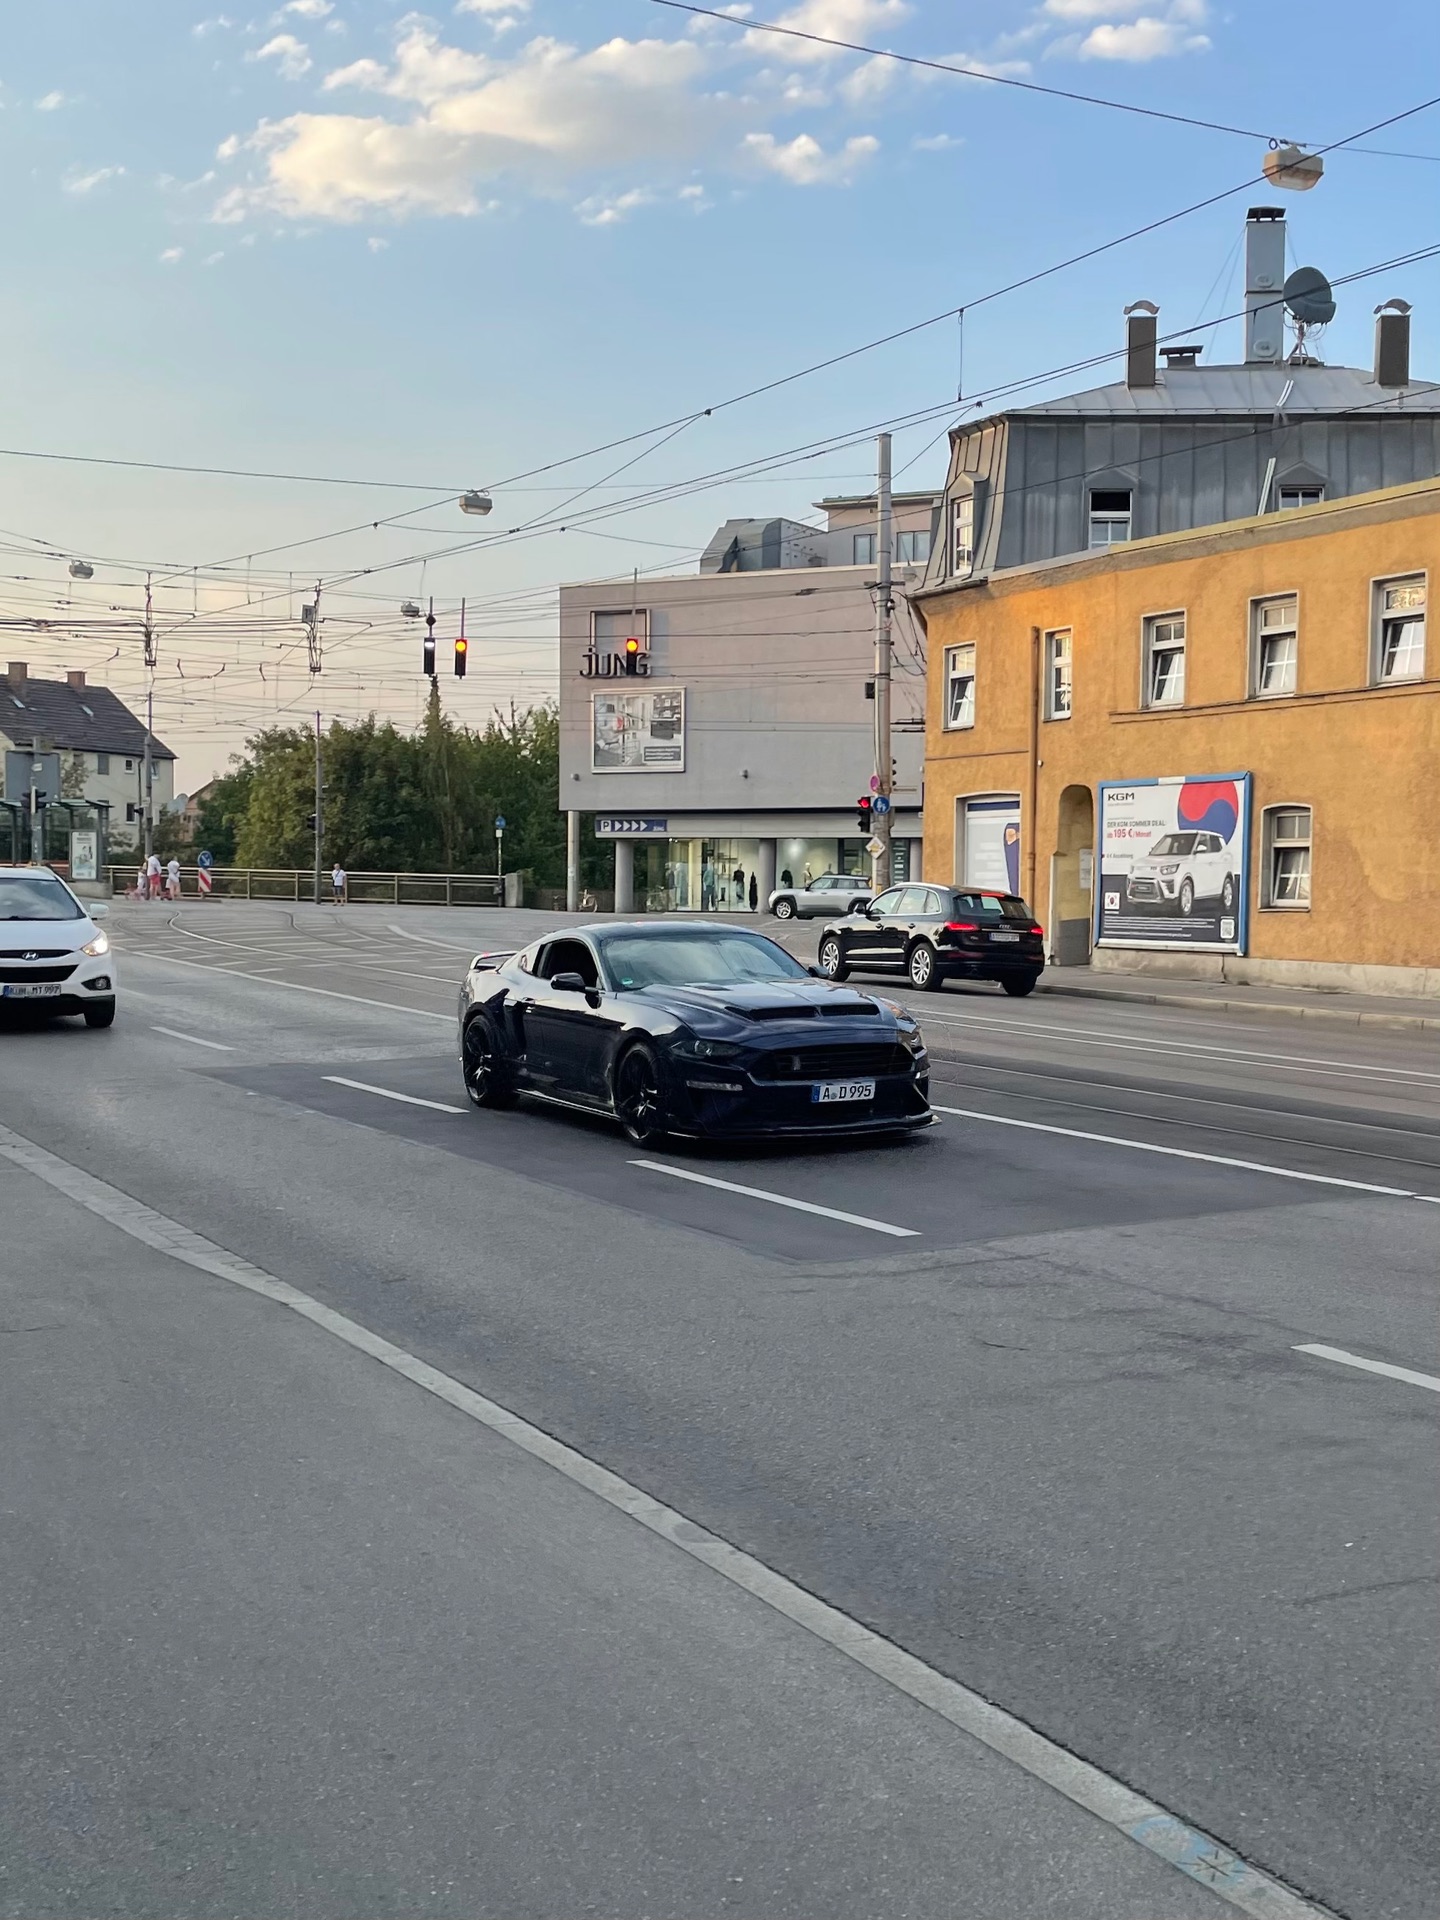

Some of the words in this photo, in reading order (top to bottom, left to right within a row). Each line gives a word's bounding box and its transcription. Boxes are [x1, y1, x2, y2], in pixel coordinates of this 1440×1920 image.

[1107, 792, 1135, 801] KGM
[1113, 828, 1127, 838] 195
[822, 1087, 830, 1100] A
[839, 1086, 847, 1099] D
[849, 1084, 872, 1098] 995
